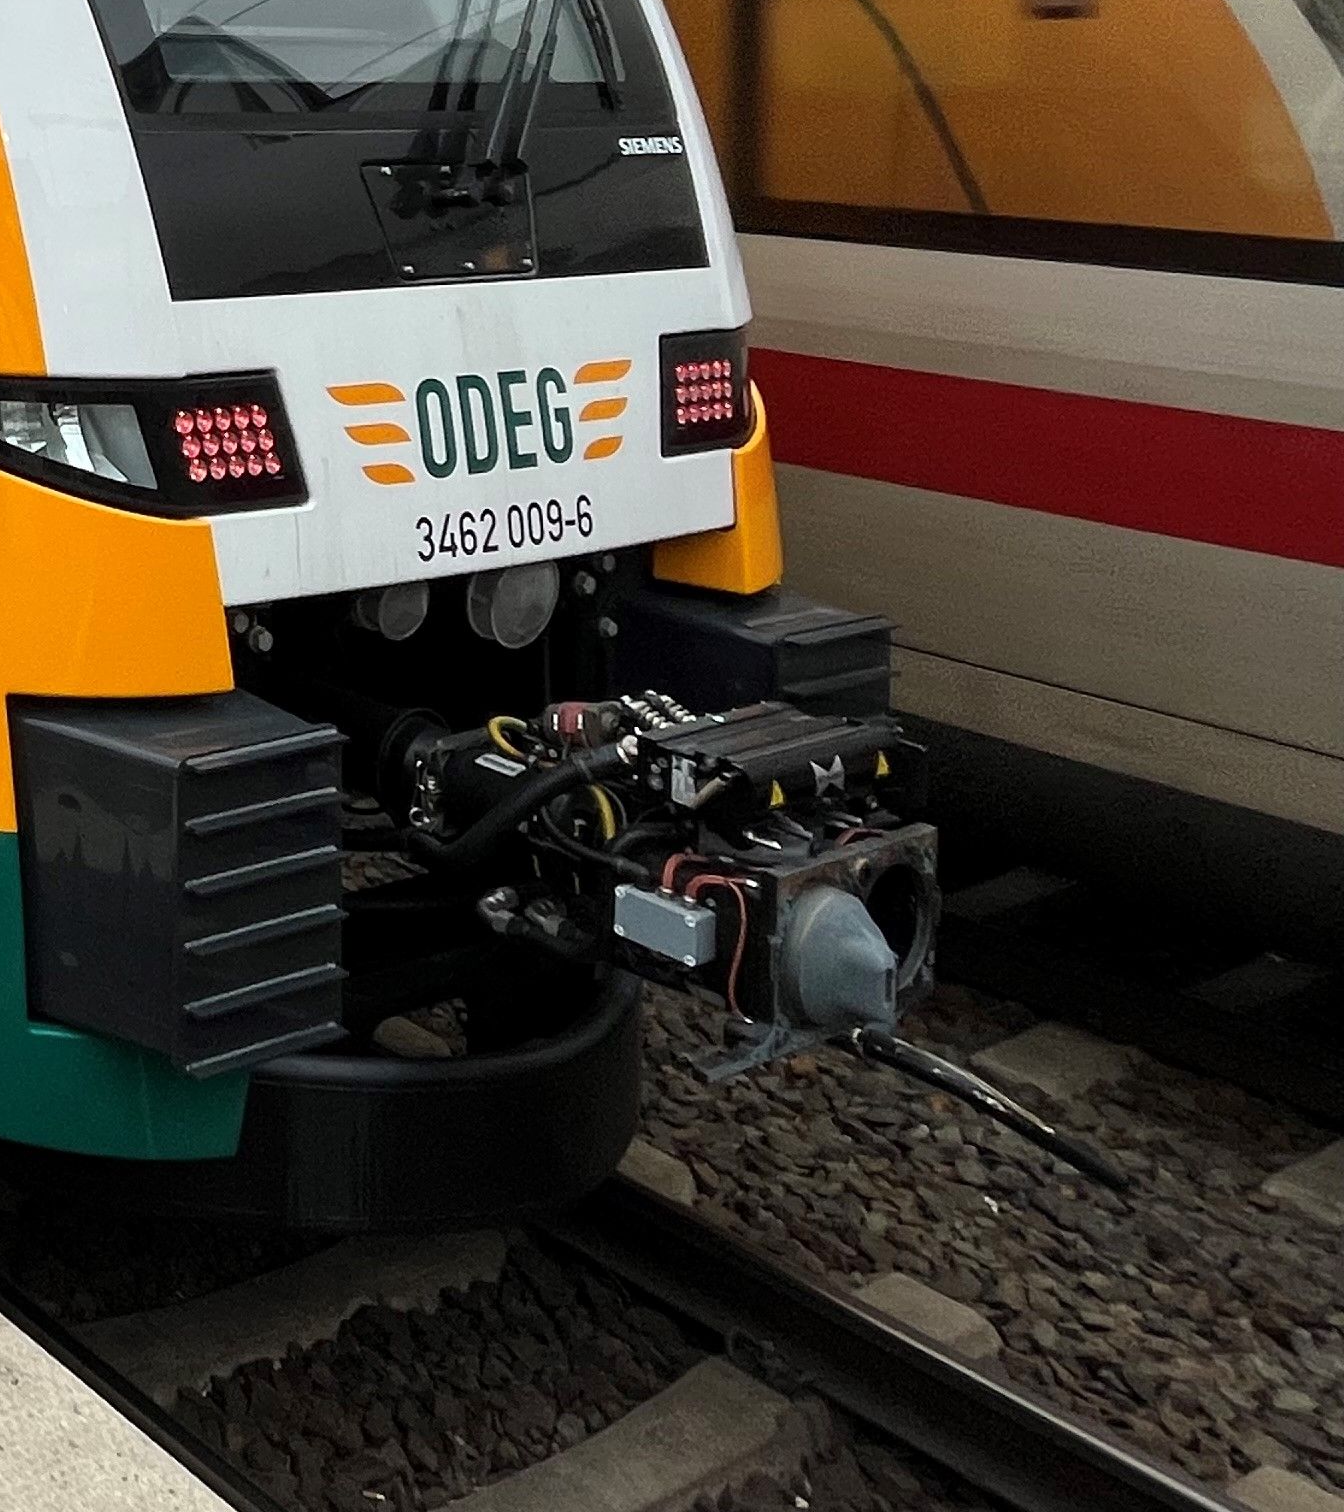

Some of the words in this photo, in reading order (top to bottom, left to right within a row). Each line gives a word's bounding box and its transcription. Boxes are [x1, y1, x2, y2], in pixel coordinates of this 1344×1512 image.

[618, 136, 684, 156] SIEMENS
[416, 367, 573, 479] ODEG
[415, 508, 499, 562] 3462
[507, 494, 593, 549] 009-6
